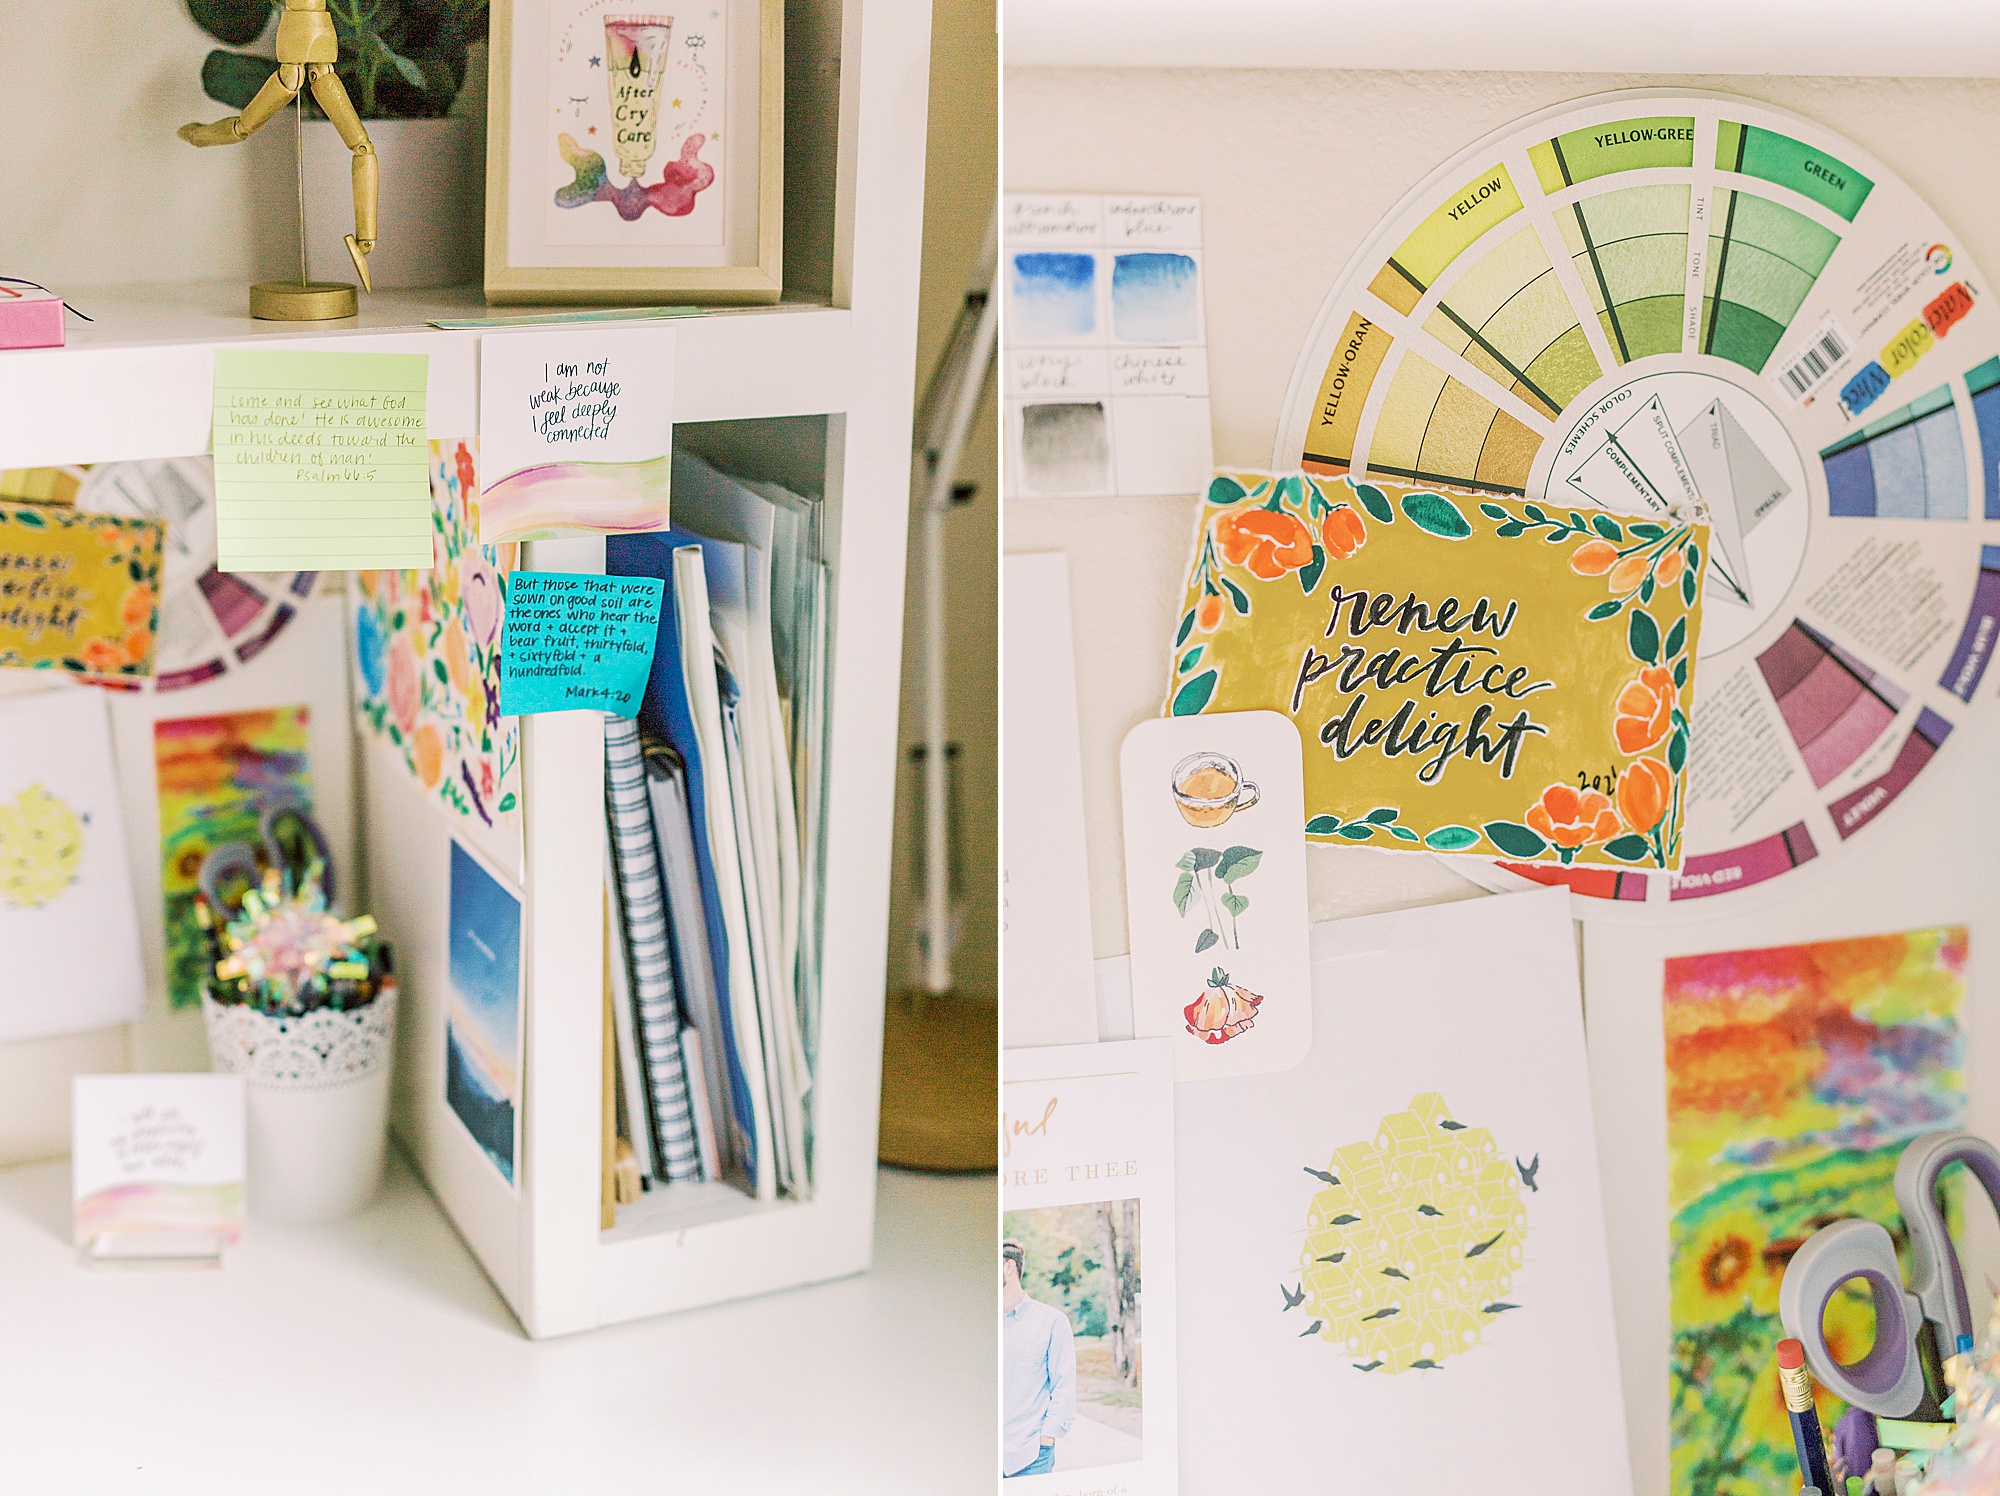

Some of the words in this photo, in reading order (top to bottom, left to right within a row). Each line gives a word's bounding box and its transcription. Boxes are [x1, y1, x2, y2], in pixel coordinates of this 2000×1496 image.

[617, 86, 654, 102] After
[615, 105, 649, 126] Cry
[617, 129, 651, 144] Care
[1804, 160, 1846, 190] GREEN
[1448, 177, 1501, 220] YELLOW
[1696, 197, 1704, 221] TINT
[1692, 252, 1700, 278] TONE
[1688, 307, 1697, 339] SHADE
[556, 362, 578, 377] am
[586, 357, 611, 377] not
[276, 394, 302, 407] and
[313, 397, 333, 409] see
[337, 395, 377, 409] what
[383, 395, 406, 409] God
[529, 385, 563, 410] weak
[564, 381, 622, 401] because
[1599, 389, 1632, 414] COLOR
[230, 411, 258, 425] has
[264, 411, 305, 426] done!
[316, 413, 334, 427] He
[340, 414, 349, 425] is
[357, 414, 423, 427] awesome
[540, 405, 566, 435] feel
[571, 399, 618, 426] deeply
[1653, 415, 1668, 439] SPLIT
[230, 431, 244, 444] in
[250, 431, 273, 445] his
[278, 431, 322, 446] deeds
[331, 433, 387, 447] toward
[546, 424, 610, 443] connected
[1564, 411, 1599, 455] SCHEMES
[236, 449, 301, 465] children
[311, 452, 324, 466] of
[1605, 447, 1661, 513] COMPLEMENTARY
[514, 578, 539, 591] But
[543, 579, 578, 591] those
[584, 580, 617, 593] that
[621, 584, 656, 596] were
[513, 594, 545, 606] sown
[550, 594, 564, 606] on
[568, 594, 597, 609] good
[601, 597, 622, 609] soil
[628, 598, 653, 608] are
[1325, 585, 1517, 638] renew
[509, 608, 531, 619] the
[533, 608, 561, 619] ones
[567, 609, 595, 621] who
[600, 610, 630, 622] hear
[634, 612, 658, 625] the
[508, 622, 541, 633] word
[559, 622, 600, 636] accept
[604, 625, 616, 637] it
[509, 635, 539, 648] bear
[593, 654, 601, 663] a
[1293, 637, 1552, 712] practice
[565, 686, 598, 698] Mark
[1320, 694, 1547, 782] delight
[1578, 766, 1617, 796] 2021
[1065, 1160, 1138, 1181] THEE
